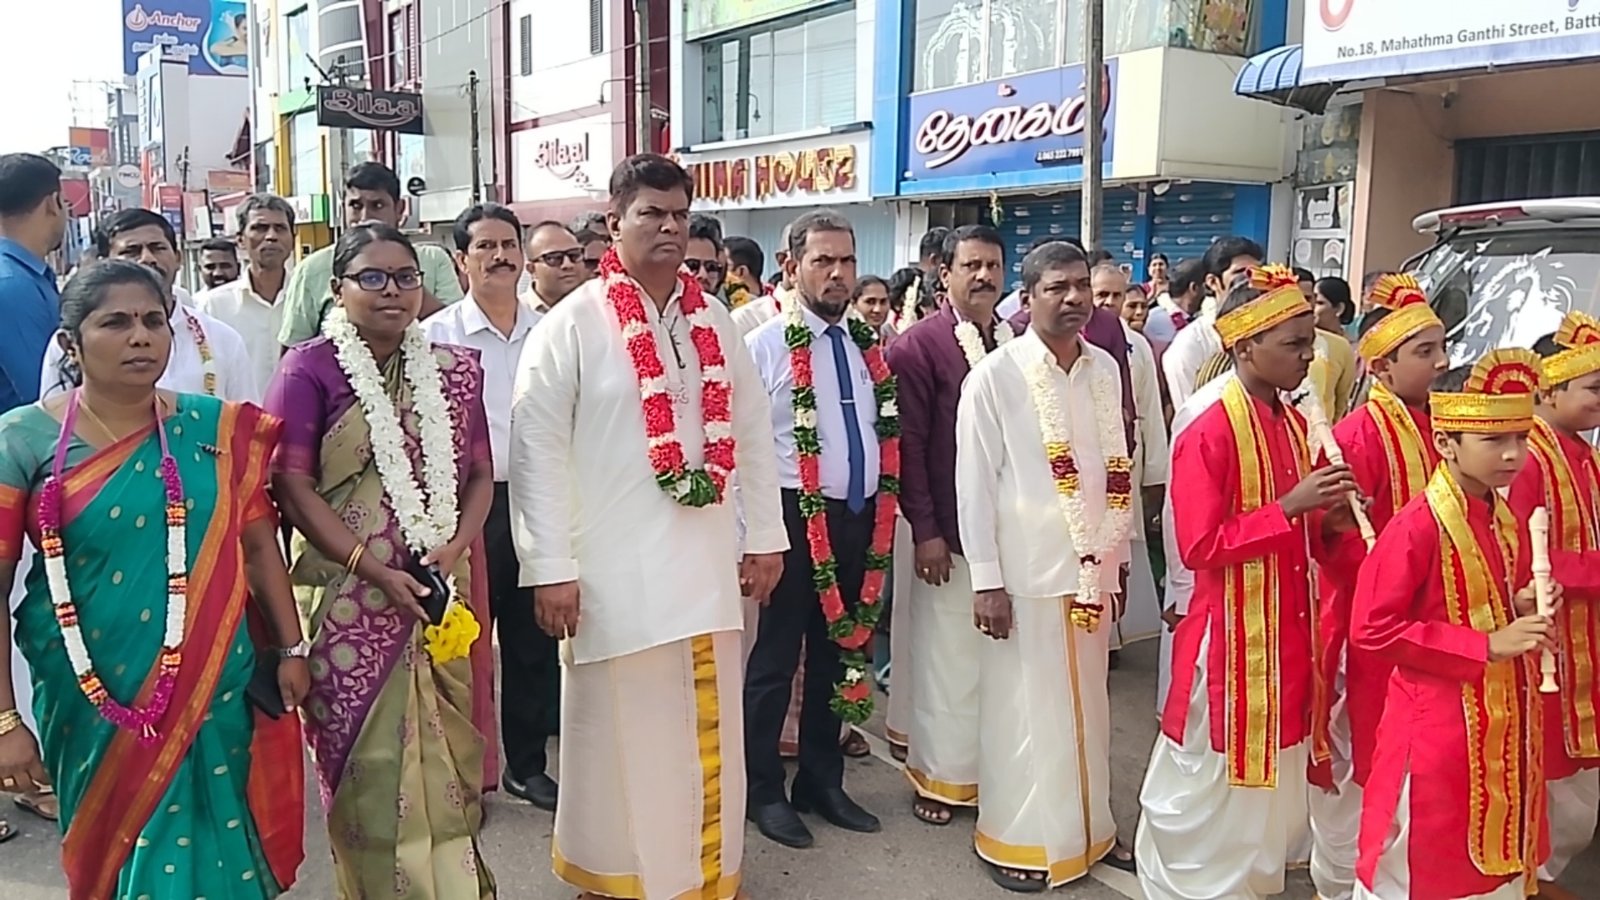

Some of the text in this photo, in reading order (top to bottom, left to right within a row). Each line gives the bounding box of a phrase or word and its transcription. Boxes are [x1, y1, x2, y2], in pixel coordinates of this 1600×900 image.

[148, 11, 200, 29] Anchor
[1337, 42, 1377, 59] No.18,
[1381, 33, 1453, 53] Mahathma
[1457, 24, 1505, 43] Ganthi
[1509, 19, 1559, 37] Street,
[755, 144, 856, 200] HOUSE
